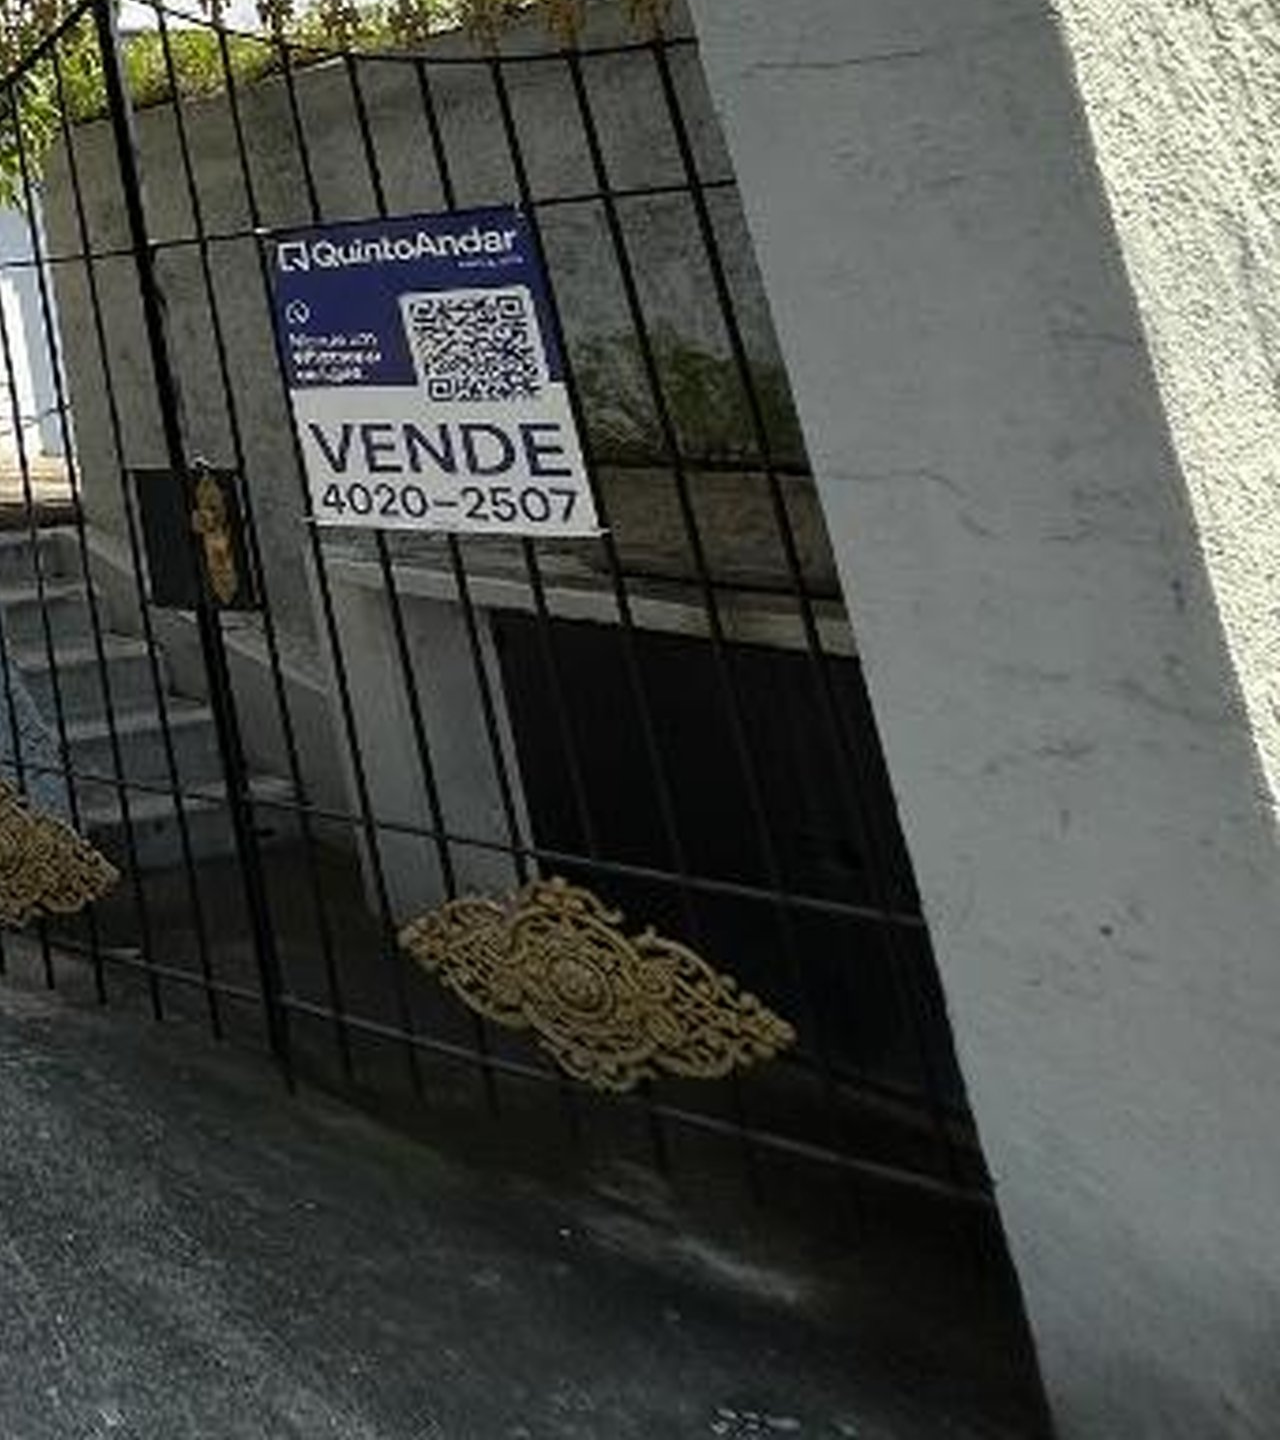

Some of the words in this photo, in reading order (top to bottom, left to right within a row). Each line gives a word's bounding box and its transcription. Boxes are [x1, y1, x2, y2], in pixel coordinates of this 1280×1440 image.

[311, 227, 518, 268] QuintoAndar
[308, 422, 572, 478] VENDE
[321, 482, 579, 523] 4020-2507
